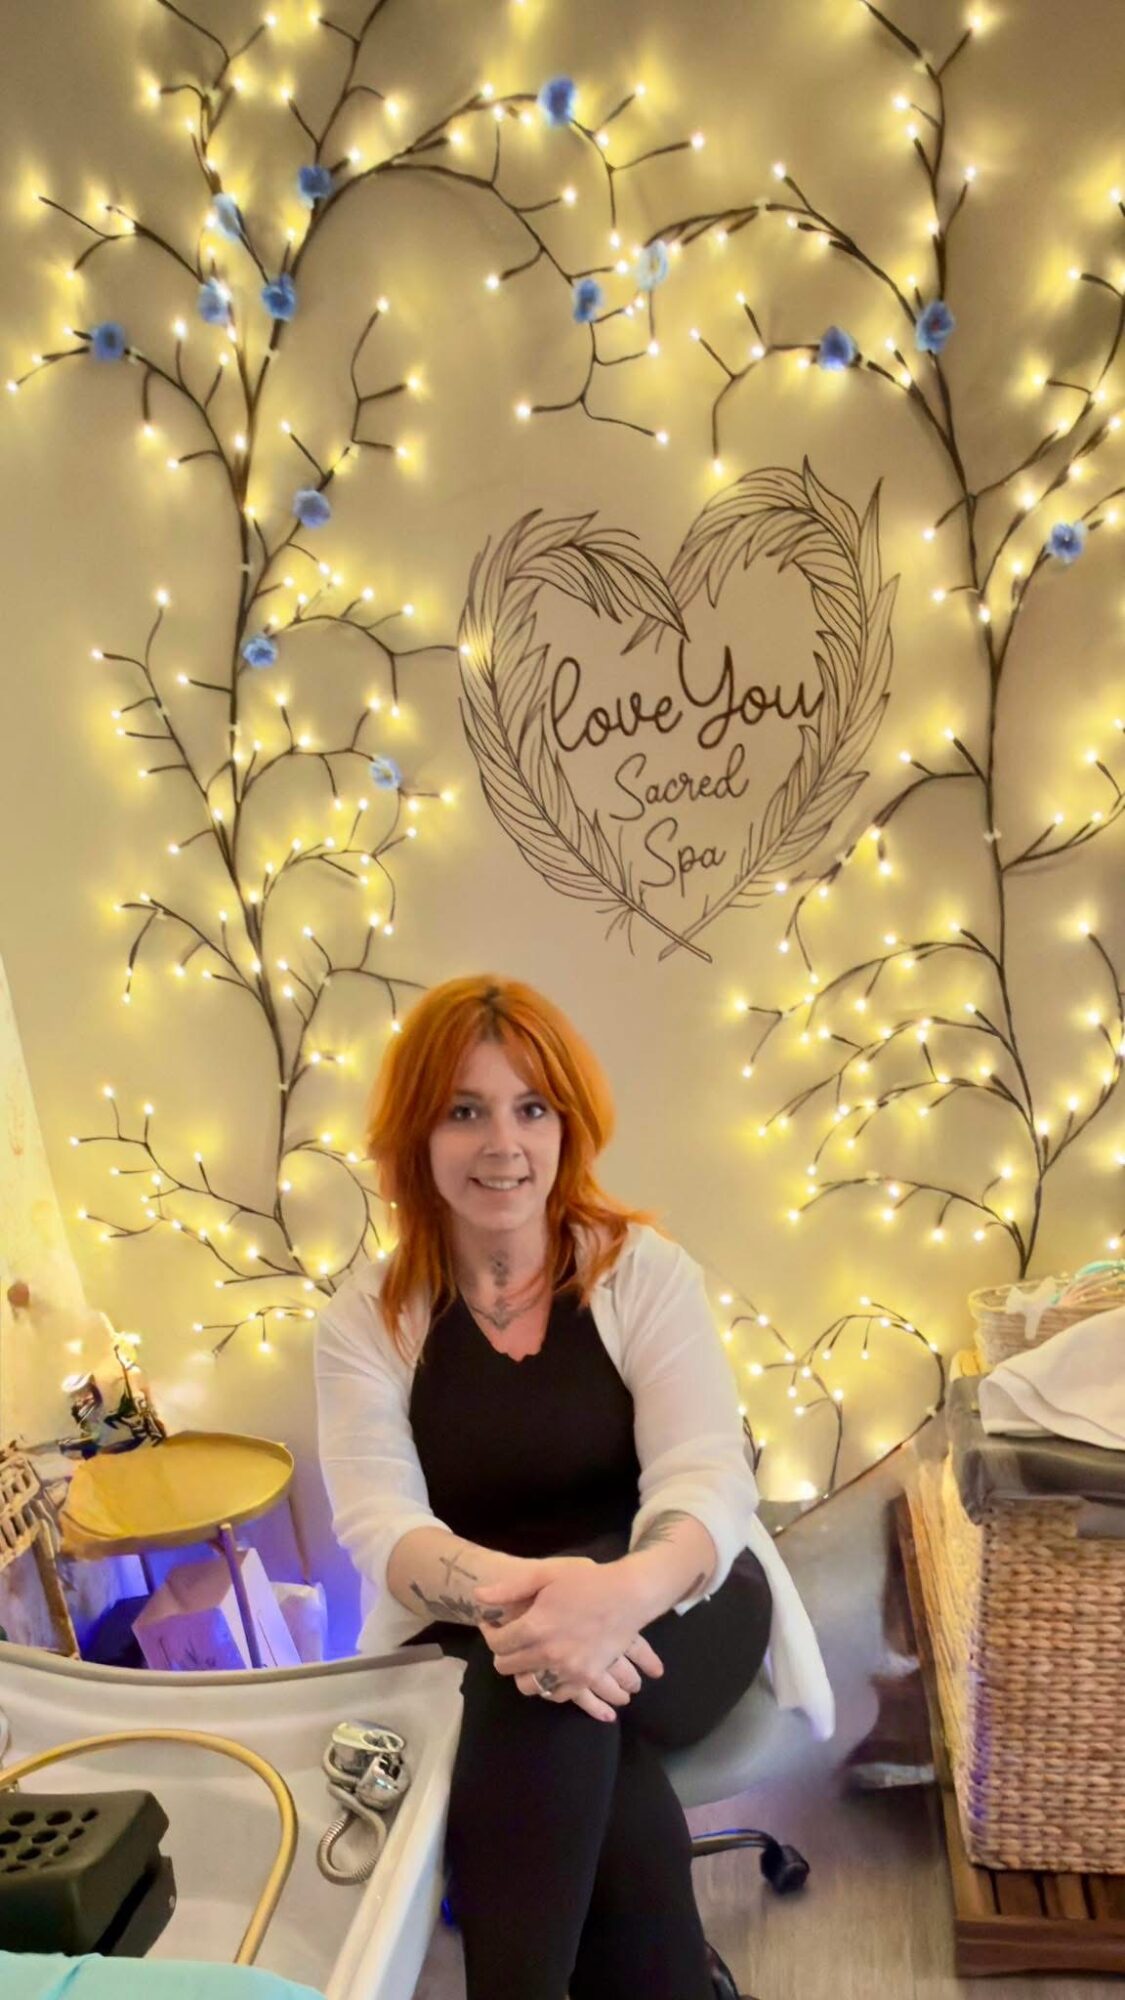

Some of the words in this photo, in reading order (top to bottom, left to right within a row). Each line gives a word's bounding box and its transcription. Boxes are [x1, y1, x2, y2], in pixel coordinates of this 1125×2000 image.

[678, 638, 825, 750] You
[610, 744, 750, 821] Sacred
[640, 817, 727, 897] Spa
